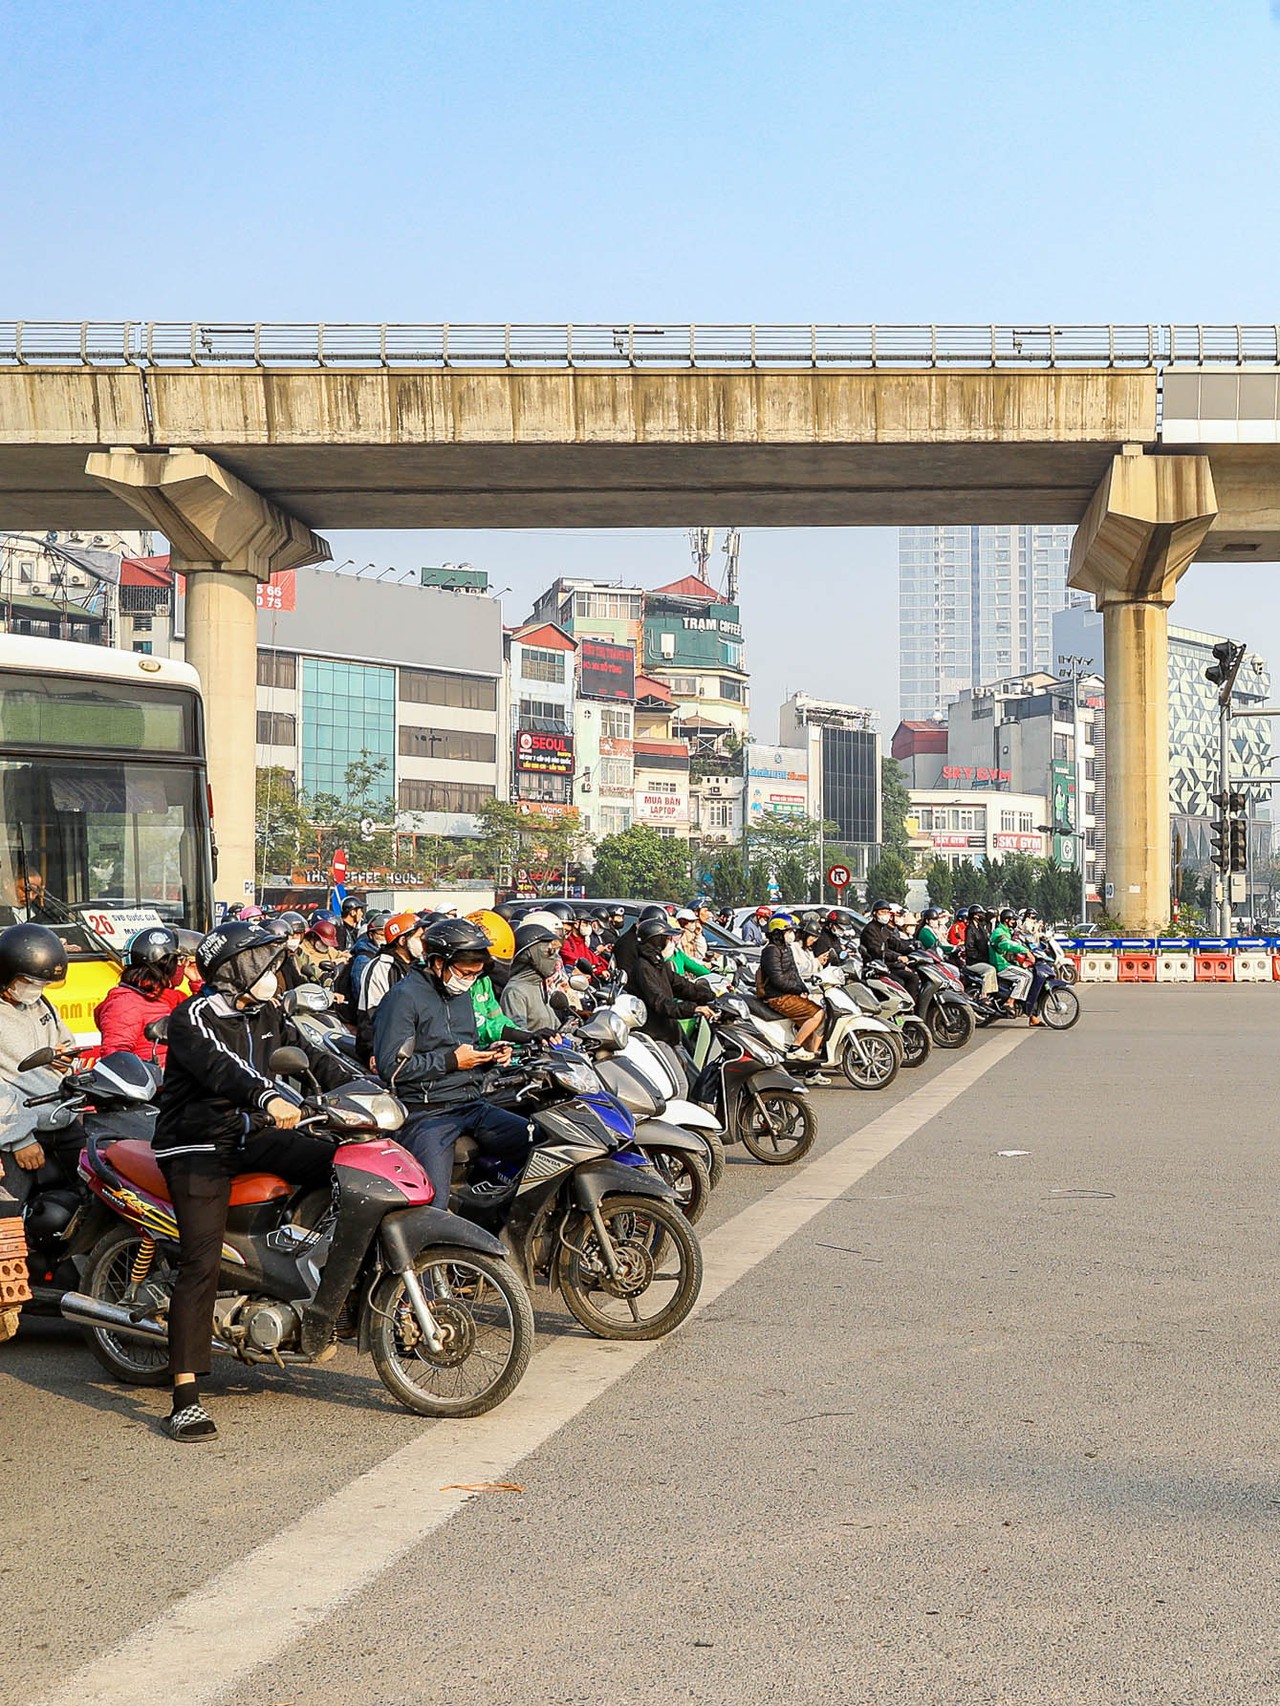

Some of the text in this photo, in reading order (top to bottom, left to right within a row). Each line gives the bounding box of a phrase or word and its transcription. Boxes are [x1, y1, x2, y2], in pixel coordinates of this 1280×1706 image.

[267, 585, 282, 597] 66
[267, 597, 282, 609] 75
[683, 617, 742, 636] TRẠM COFFEE
[532, 736, 567, 751] SEOUL
[943, 766, 1012, 783] SKY GYM
[644, 796, 662, 804] MUA
[650, 806, 676, 815] LAPTOP
[935, 836, 949, 844] SKY
[998, 835, 1041, 850] SKY GYM
[305, 870, 328, 883] THE
[386, 872, 424, 884] HOUSE
[89, 914, 115, 934] 26
[535, 1154, 562, 1168] HONDA
